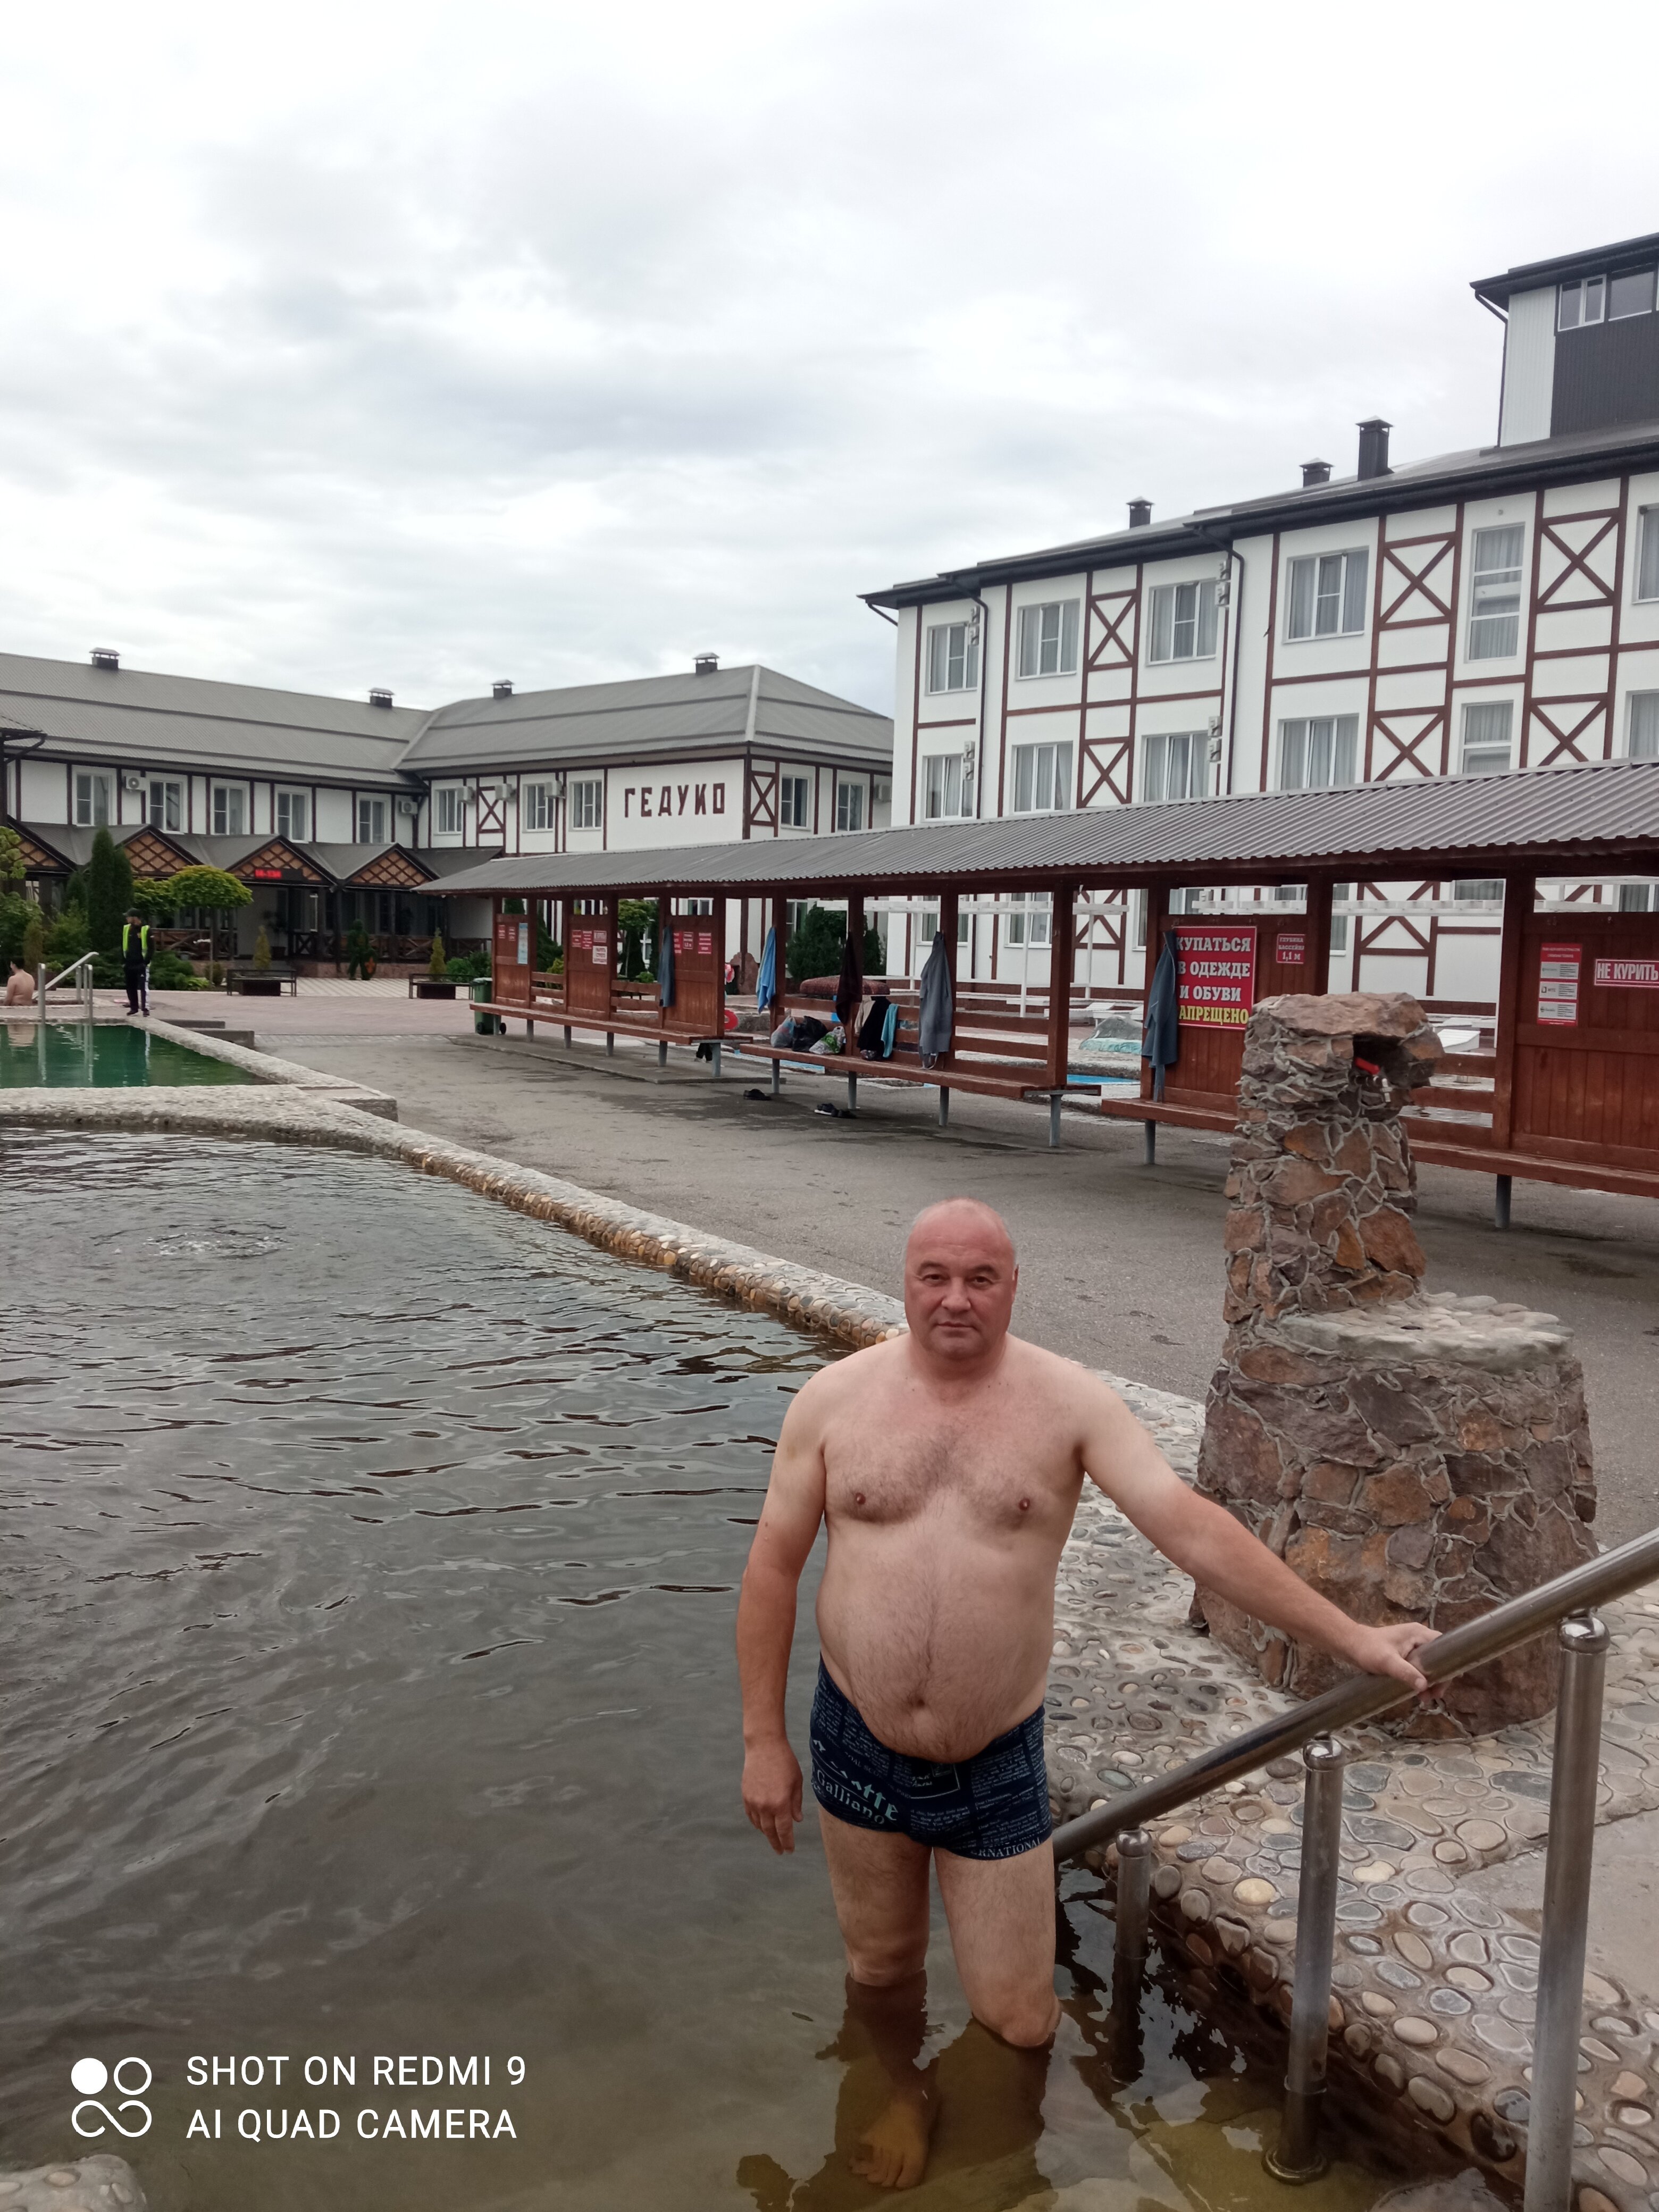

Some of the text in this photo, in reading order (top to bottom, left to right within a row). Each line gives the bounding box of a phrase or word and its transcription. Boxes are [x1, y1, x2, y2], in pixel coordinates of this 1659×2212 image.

[625, 783, 725, 818] ГЕДУКО
[1176, 937, 1251, 952] КУПАТЬСЯ
[1177, 961, 1251, 979] В ОДЕЖДЕ
[1597, 962, 1611, 979] НЕ
[1613, 963, 1659, 981] КУРИТЬ
[1179, 985, 1242, 1002] И ОБУВИ
[1178, 1005, 1250, 1026] АПРЕЩЕНО
[817, 1769, 885, 1825] Galliano
